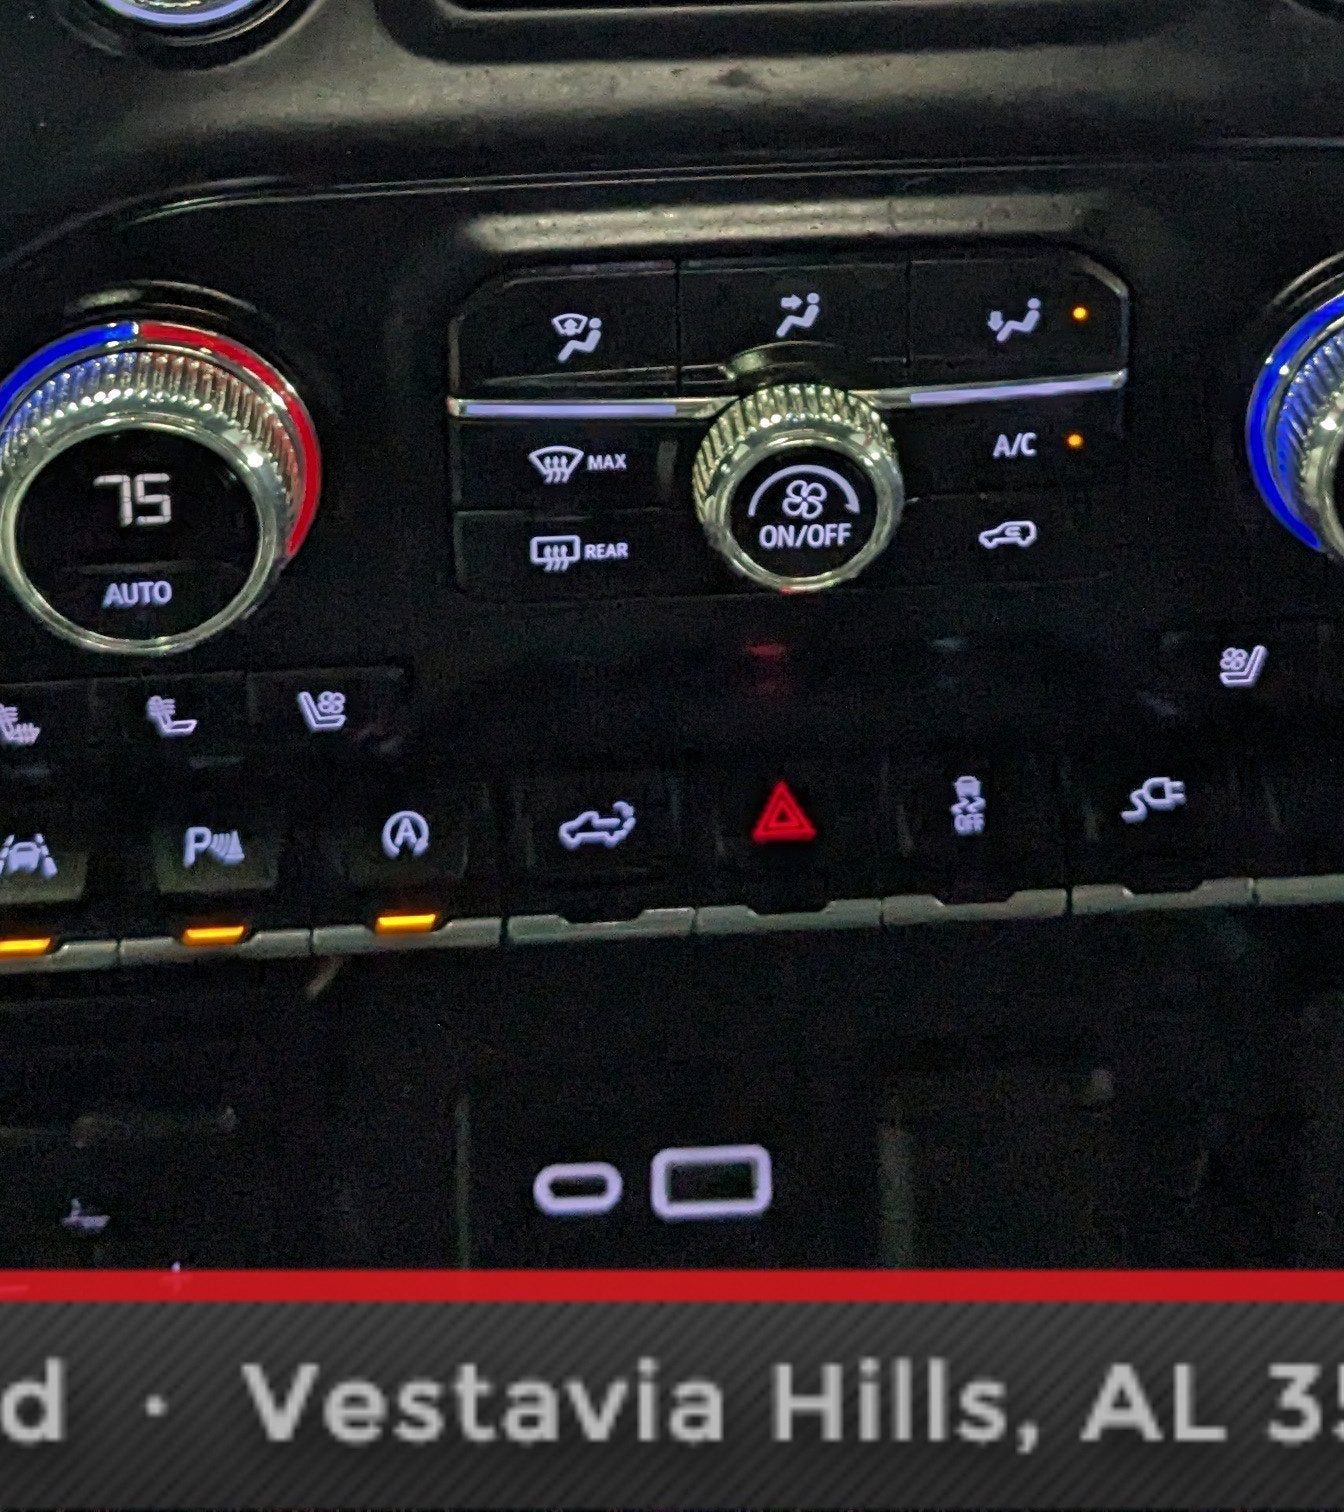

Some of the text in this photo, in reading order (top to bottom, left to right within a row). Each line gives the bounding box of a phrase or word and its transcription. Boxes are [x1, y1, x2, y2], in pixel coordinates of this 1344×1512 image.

[992, 431, 1037, 458] A/C
[587, 453, 627, 471] MAX
[93, 473, 172, 526] 75
[758, 521, 853, 549] ON/OFF
[583, 542, 629, 560] REAR
[103, 580, 173, 608] AUTO
[951, 812, 984, 835] OFF
